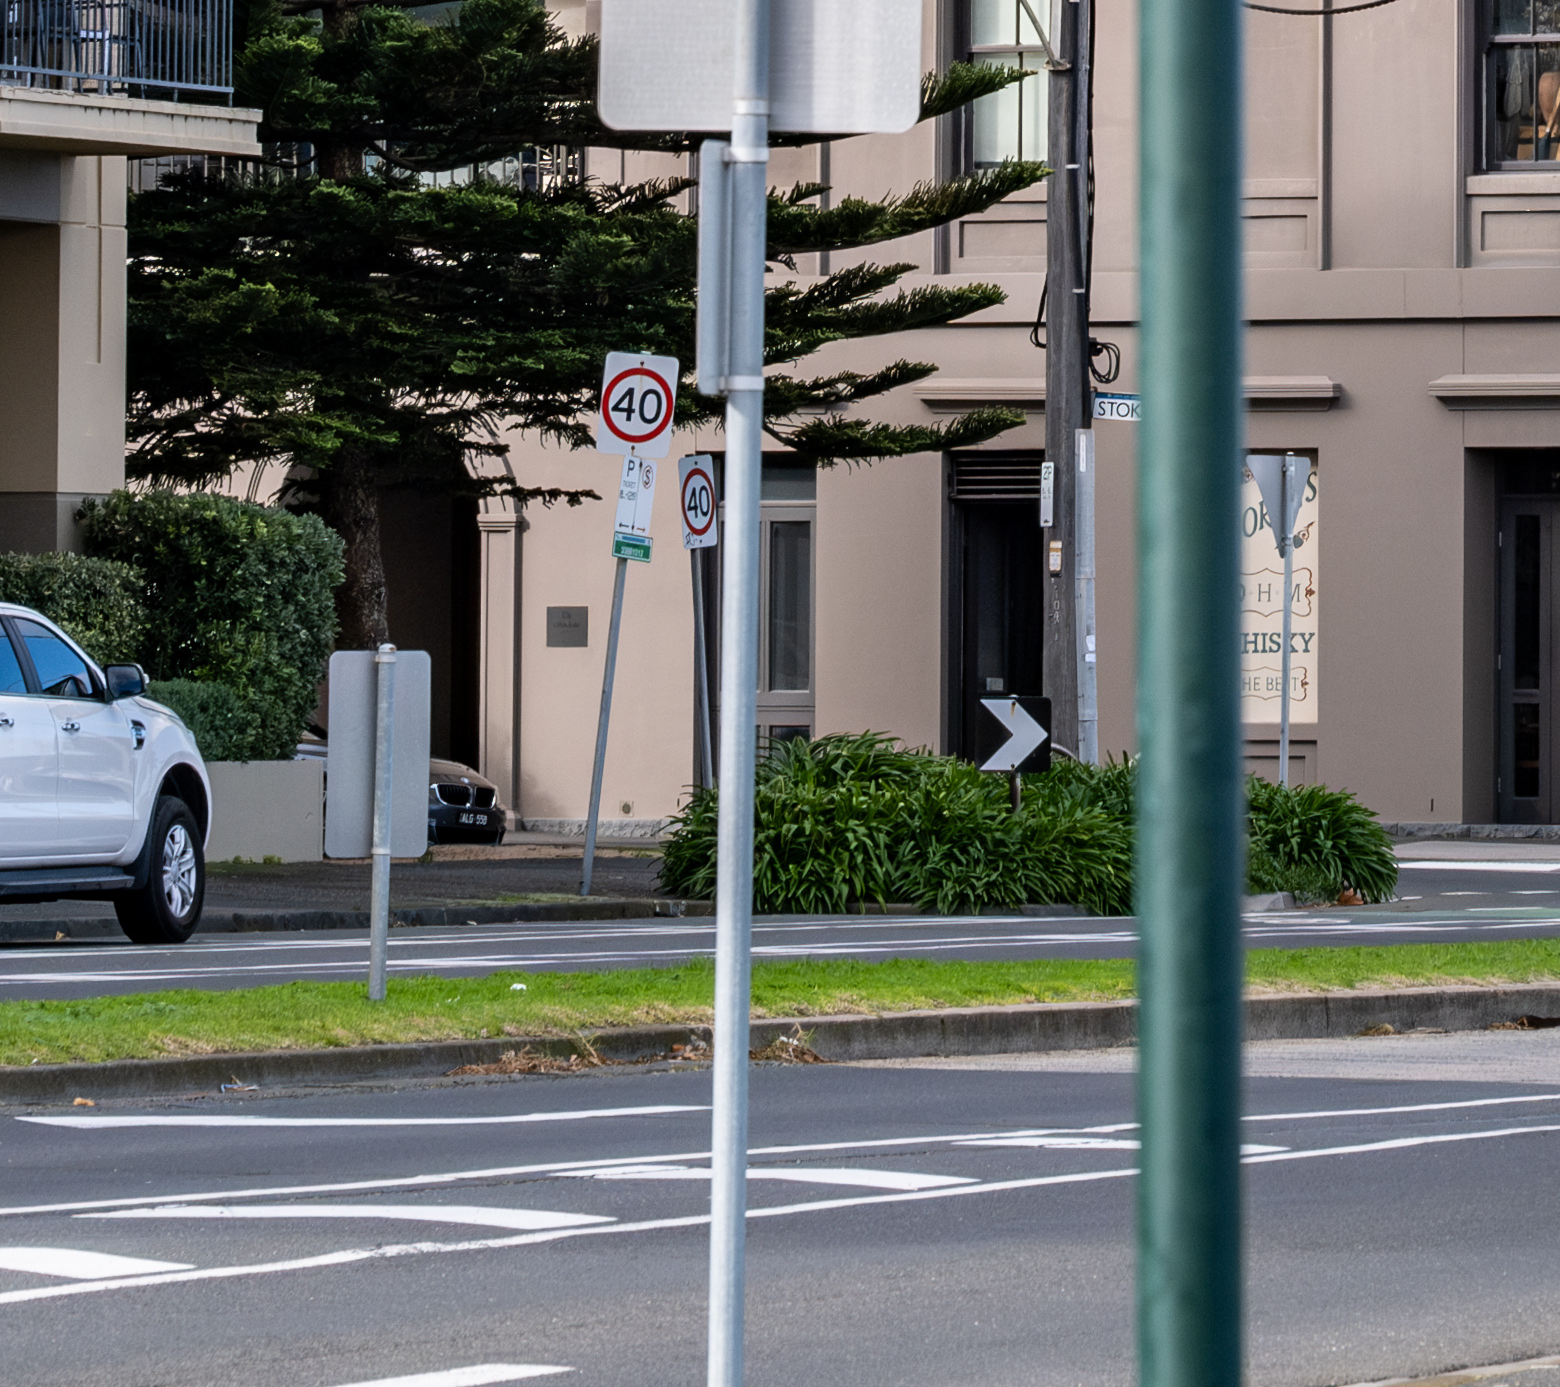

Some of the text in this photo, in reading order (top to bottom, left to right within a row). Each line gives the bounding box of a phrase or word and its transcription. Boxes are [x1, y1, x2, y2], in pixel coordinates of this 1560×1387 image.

[611, 387, 662, 424] 40
[1098, 400, 1140, 419] STOK
[687, 485, 710, 518] 40
[1240, 632, 1316, 654] HISKY
[1242, 676, 1300, 692] HE BET
